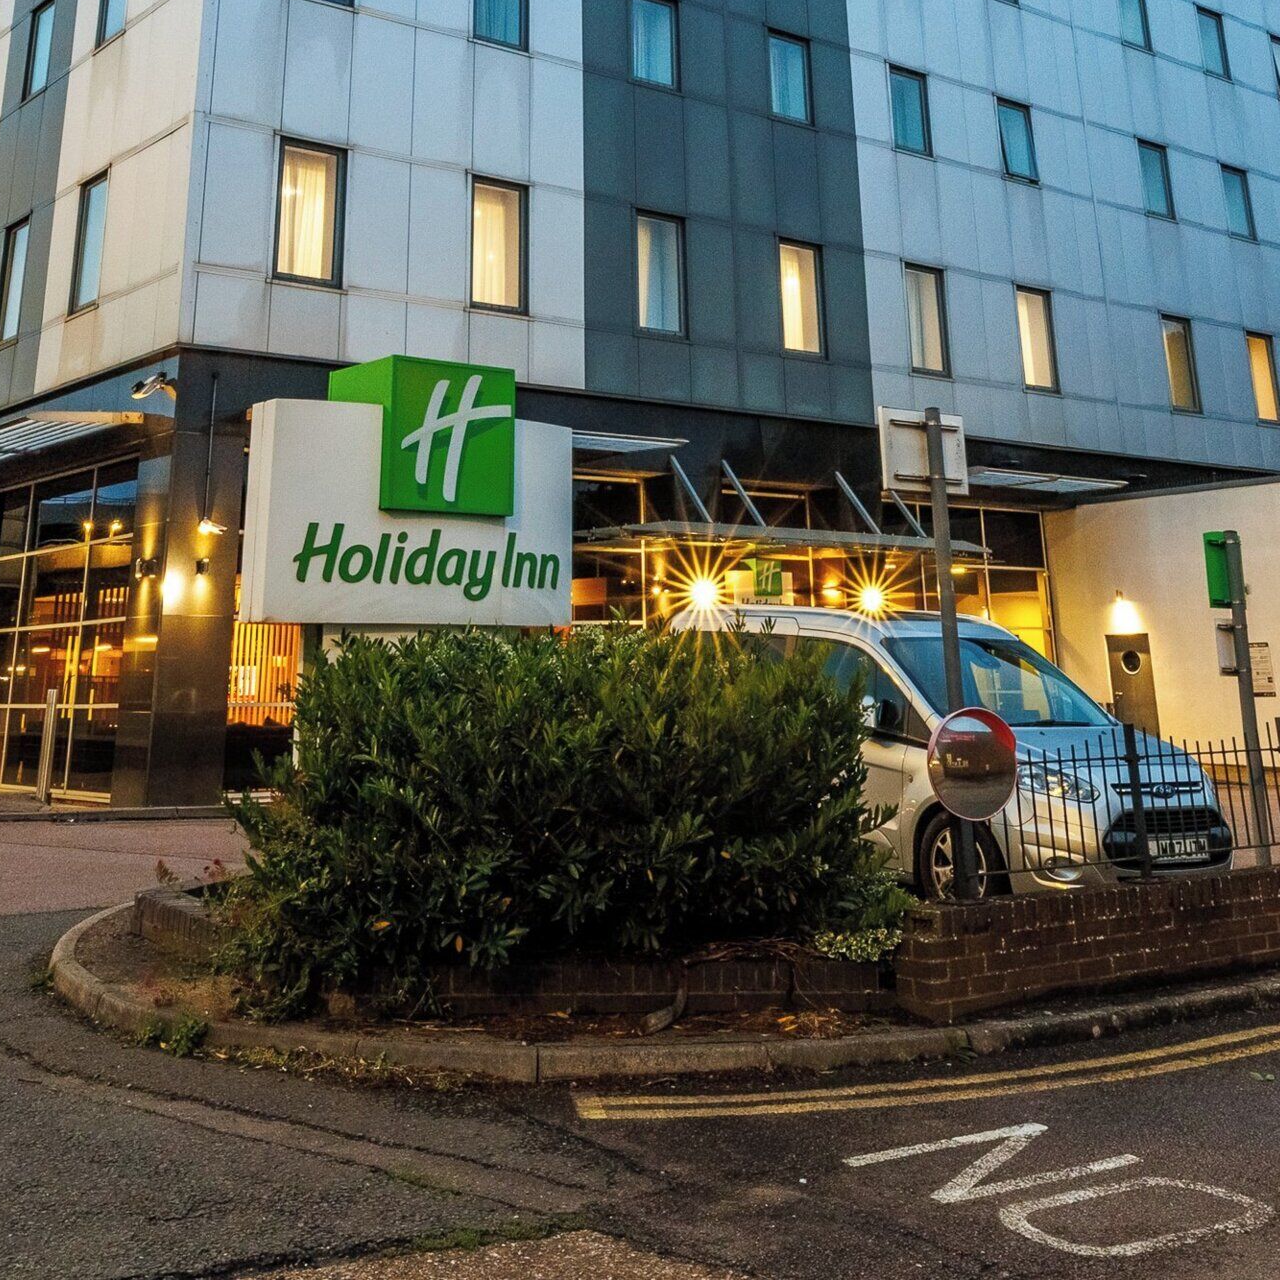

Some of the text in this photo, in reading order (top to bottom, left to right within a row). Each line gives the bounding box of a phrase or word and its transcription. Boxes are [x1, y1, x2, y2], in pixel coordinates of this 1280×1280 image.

[292, 522, 560, 601] Holiday Inn
[842, 1122, 1276, 1258] NO
